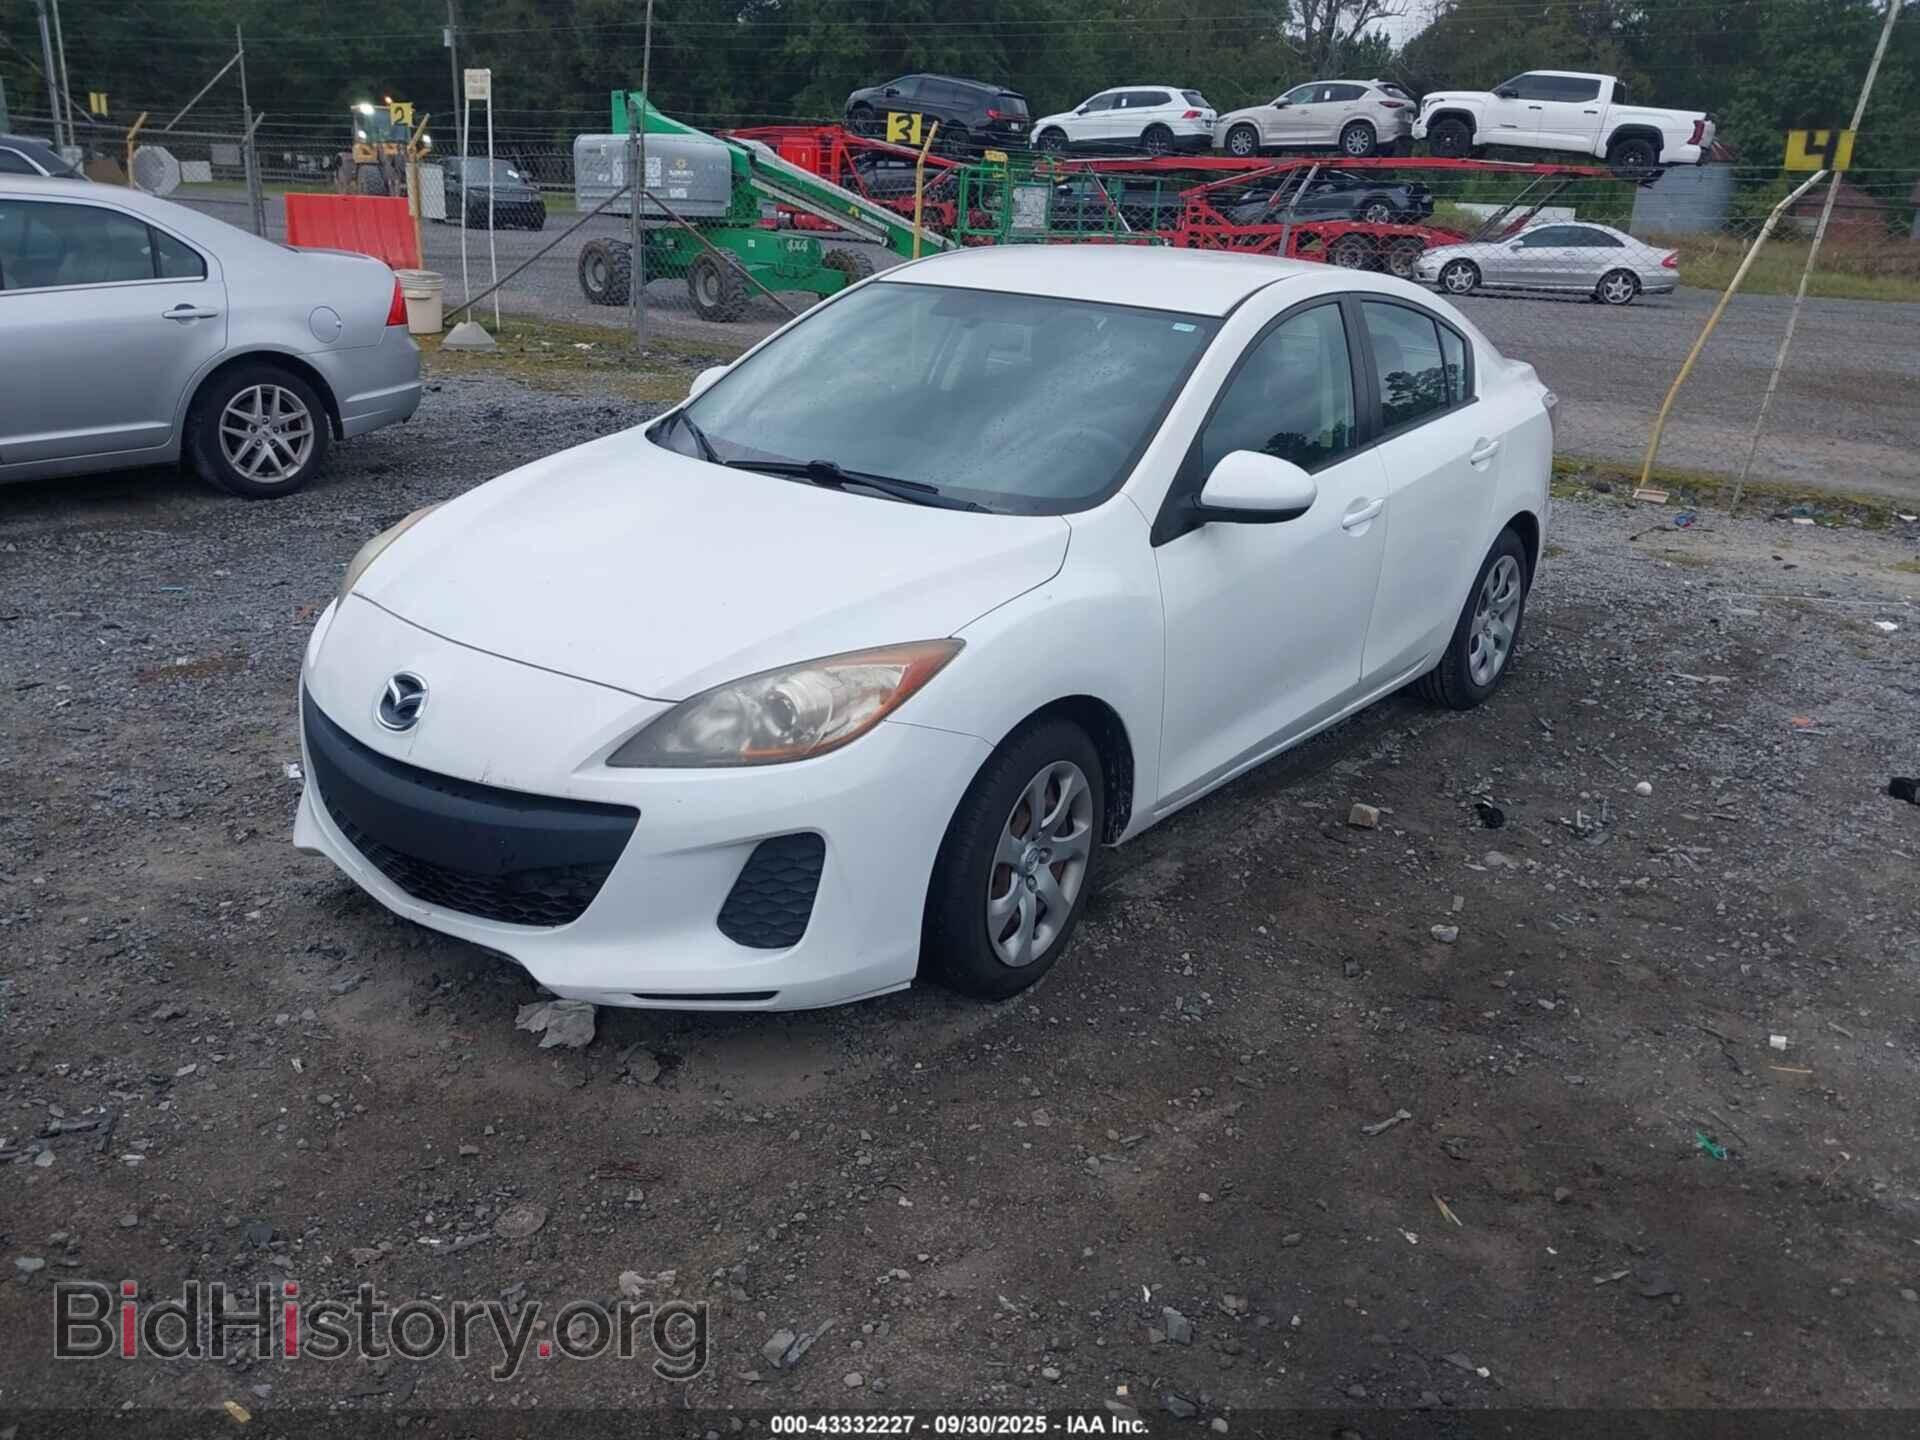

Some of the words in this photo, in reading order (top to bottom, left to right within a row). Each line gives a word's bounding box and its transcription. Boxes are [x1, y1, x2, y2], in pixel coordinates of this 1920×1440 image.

[394, 106, 407, 125] 2
[896, 113, 914, 143] 3
[1804, 129, 1840, 170] 4
